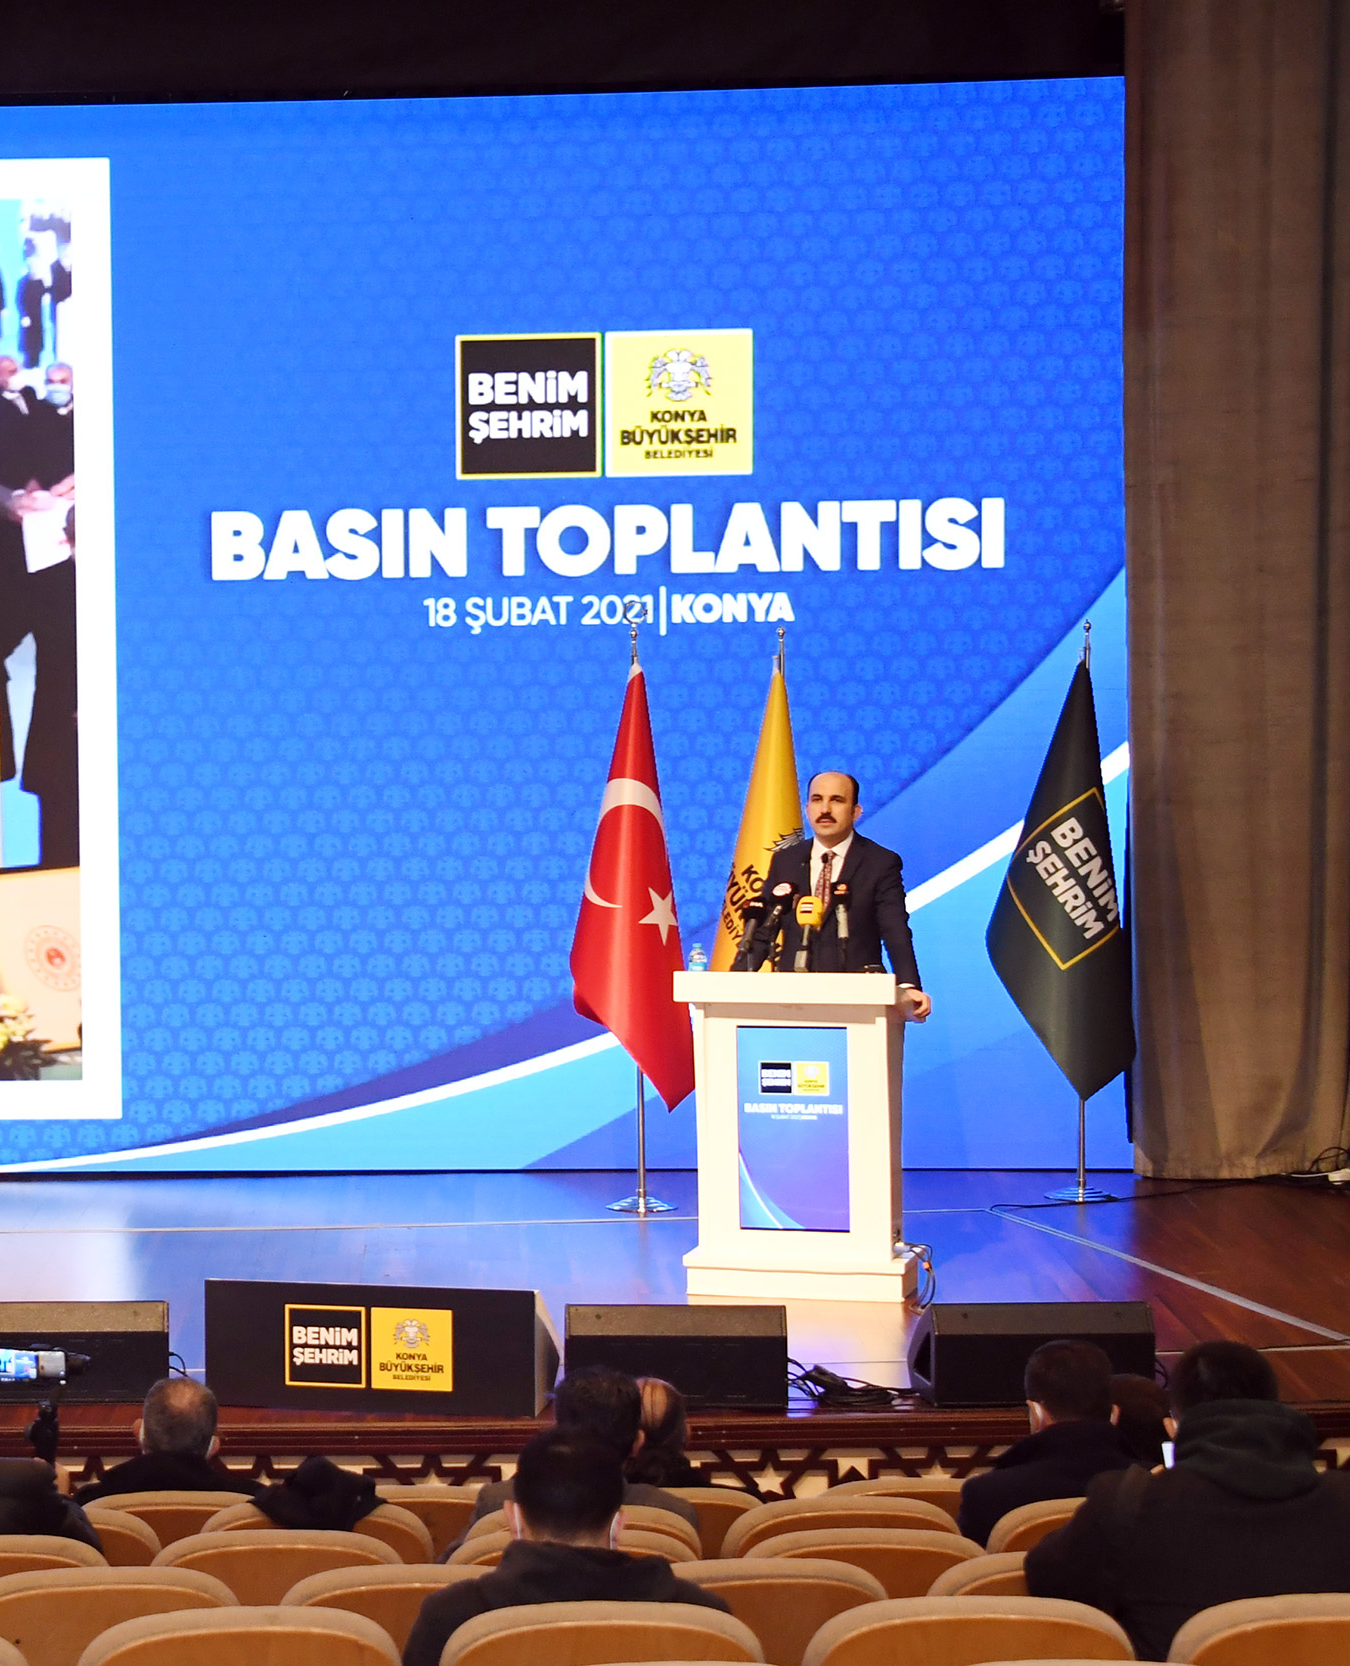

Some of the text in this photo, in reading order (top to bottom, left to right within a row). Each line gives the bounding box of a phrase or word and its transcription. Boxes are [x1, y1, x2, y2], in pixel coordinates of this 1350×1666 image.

[650, 410, 707, 423] KONYA
[620, 424, 737, 446] BÜYÜKŞEHİR
[211, 497, 1006, 581] BASIN TOPLANTISI
[423, 592, 796, 635] 18 ŞUBAT 2021 KONYA
[395, 1352, 428, 1362] KONYA
[379, 1360, 444, 1375] BÜYÜKŞEHİR
